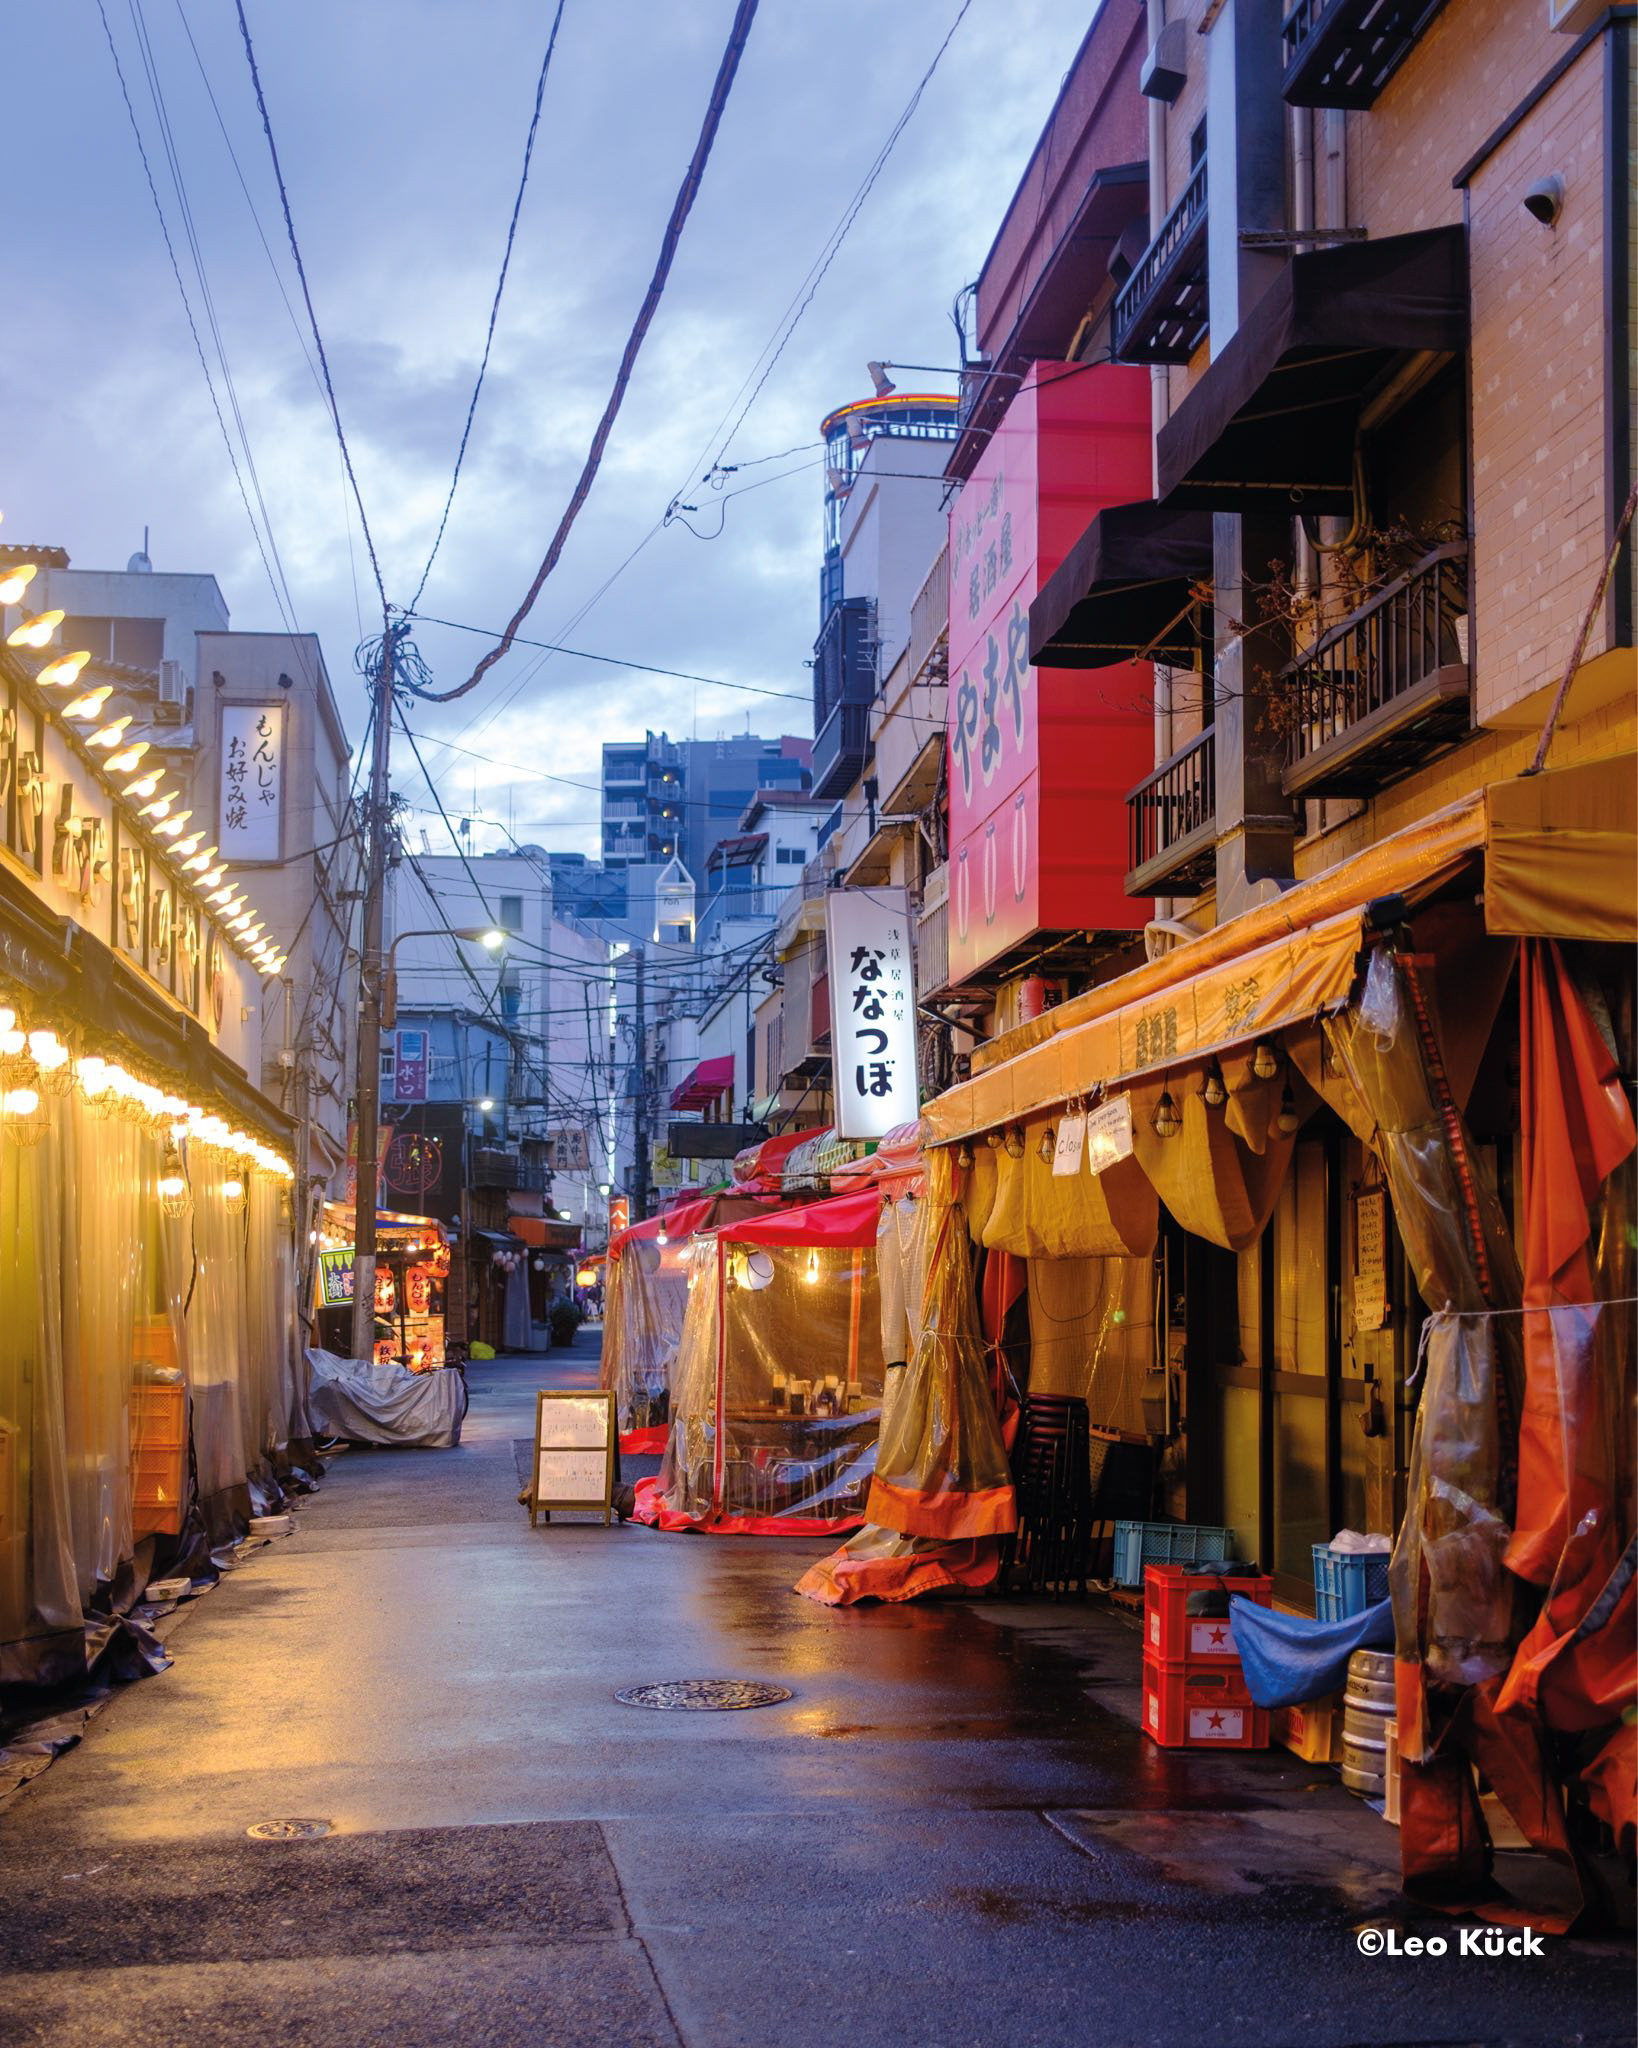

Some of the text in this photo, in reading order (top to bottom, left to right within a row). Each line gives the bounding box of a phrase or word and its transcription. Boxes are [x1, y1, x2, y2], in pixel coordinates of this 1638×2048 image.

[969, 511, 1013, 621] 居酒屋
[953, 598, 1030, 799] やまや
[225, 736, 249, 831] お好み焼
[252, 714, 276, 807] もんじゃ
[850, 945, 896, 1098] ななつぼ
[887, 928, 905, 1023] 浅草居酒屋
[398, 1063, 415, 1095] 水口
[412, 1273, 423, 1305] もんじゃ
[1232, 1711, 1241, 1719] 20
